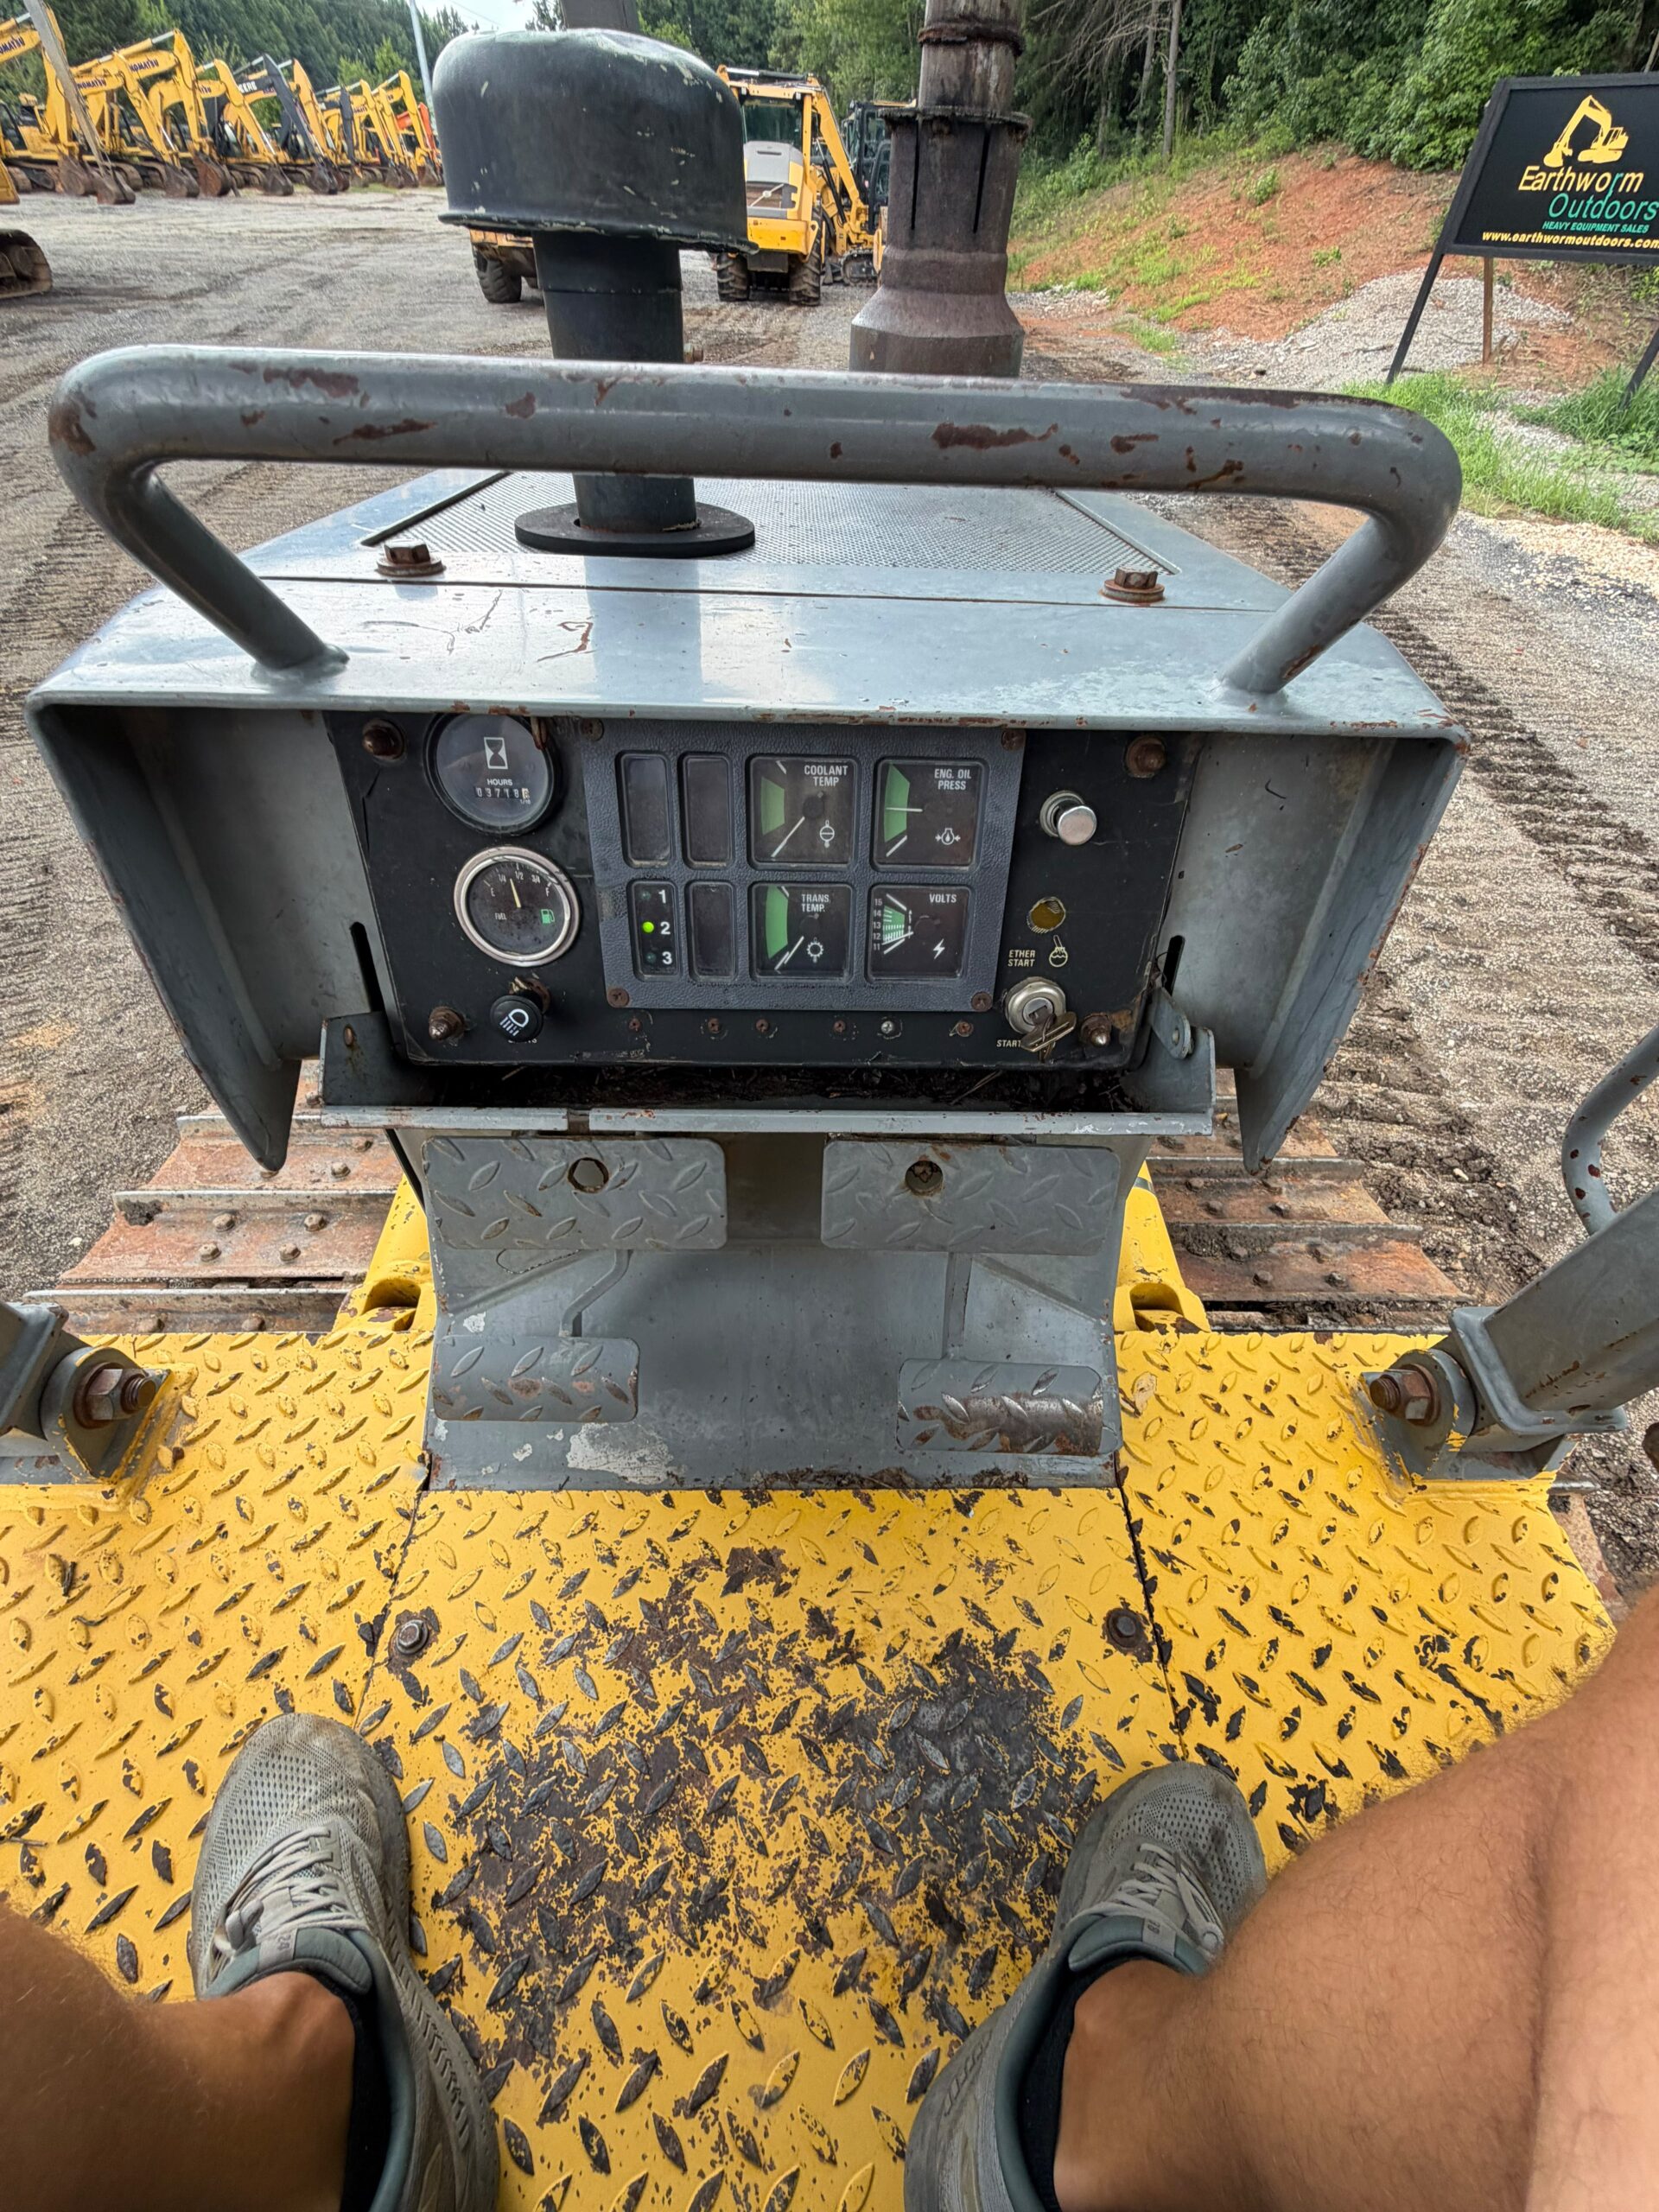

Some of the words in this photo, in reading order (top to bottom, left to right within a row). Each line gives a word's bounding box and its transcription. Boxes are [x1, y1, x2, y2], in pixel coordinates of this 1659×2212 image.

[1518, 164, 1644, 194] Earthworm
[1548, 192, 1659, 221] Outdoors
[1541, 220, 1571, 231] HEAVY
[1570, 222, 1620, 232] EQUIPMENT
[1620, 224, 1649, 233] SALES
[1482, 231, 1659, 249] www.earthwormoutdoors.com
[804, 765, 849, 776] COOLANT
[934, 769, 955, 779] ENG.
[957, 770, 971, 779] OIL
[813, 776, 839, 787] TEMP
[938, 779, 966, 791] PRESS
[514, 870, 524, 880] 1/2
[490, 887, 496, 897] E
[545, 887, 550, 897] F
[658, 889, 666, 904] 1
[929, 893, 957, 903] VOLTS
[801, 903, 826, 912] TEMP.
[660, 921, 671, 935] 2
[873, 921, 881, 930] 13
[662, 951, 672, 965] 3
[1008, 950, 1036, 958] ETHER
[1007, 958, 1035, 967] START
